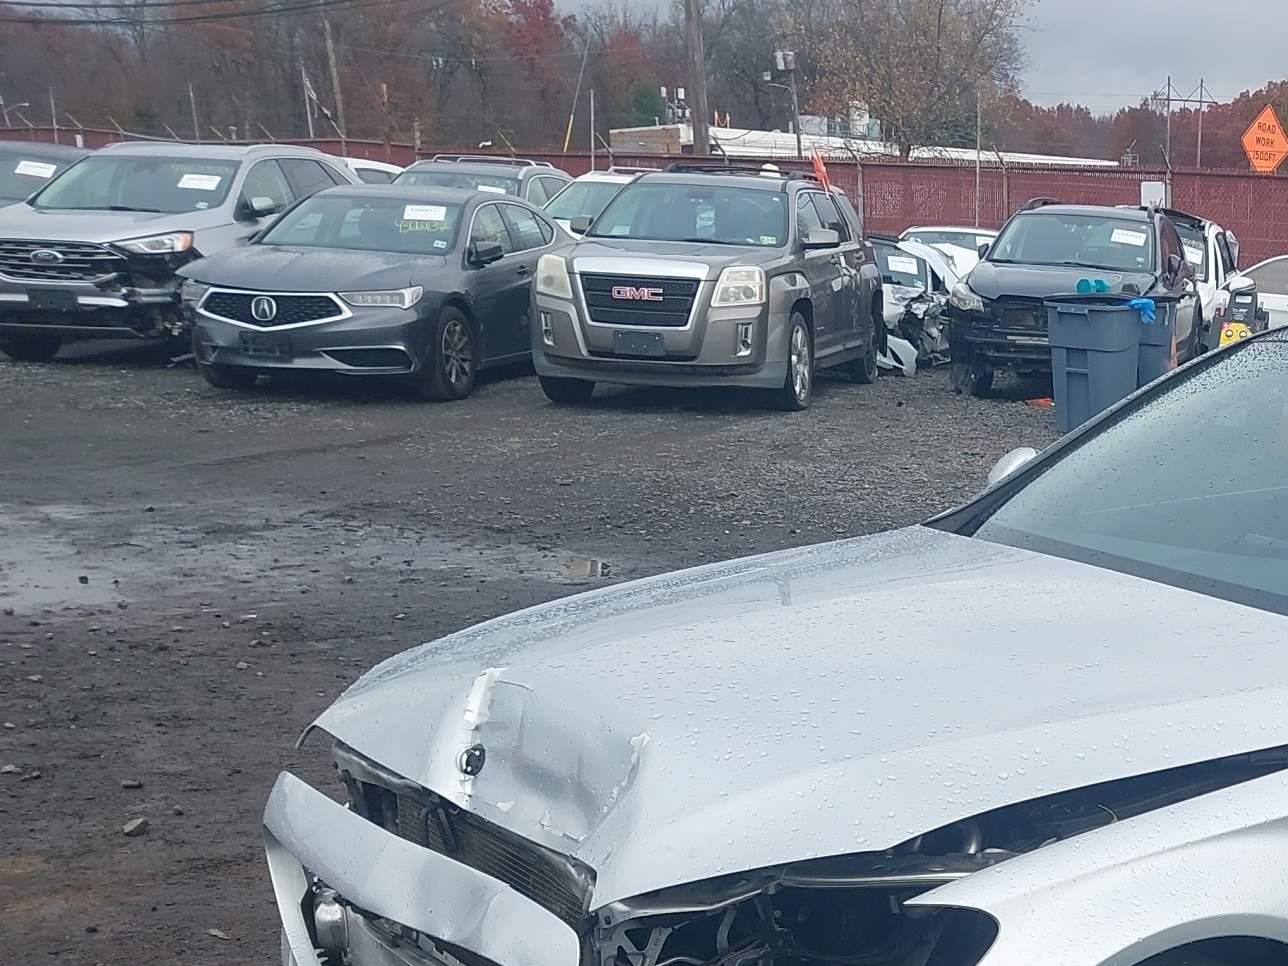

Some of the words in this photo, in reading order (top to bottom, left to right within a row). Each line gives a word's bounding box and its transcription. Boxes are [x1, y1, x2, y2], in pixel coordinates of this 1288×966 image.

[1257, 121, 1277, 135] ROAD
[1255, 136, 1275, 149] WORK
[612, 286, 663, 301] GMC
